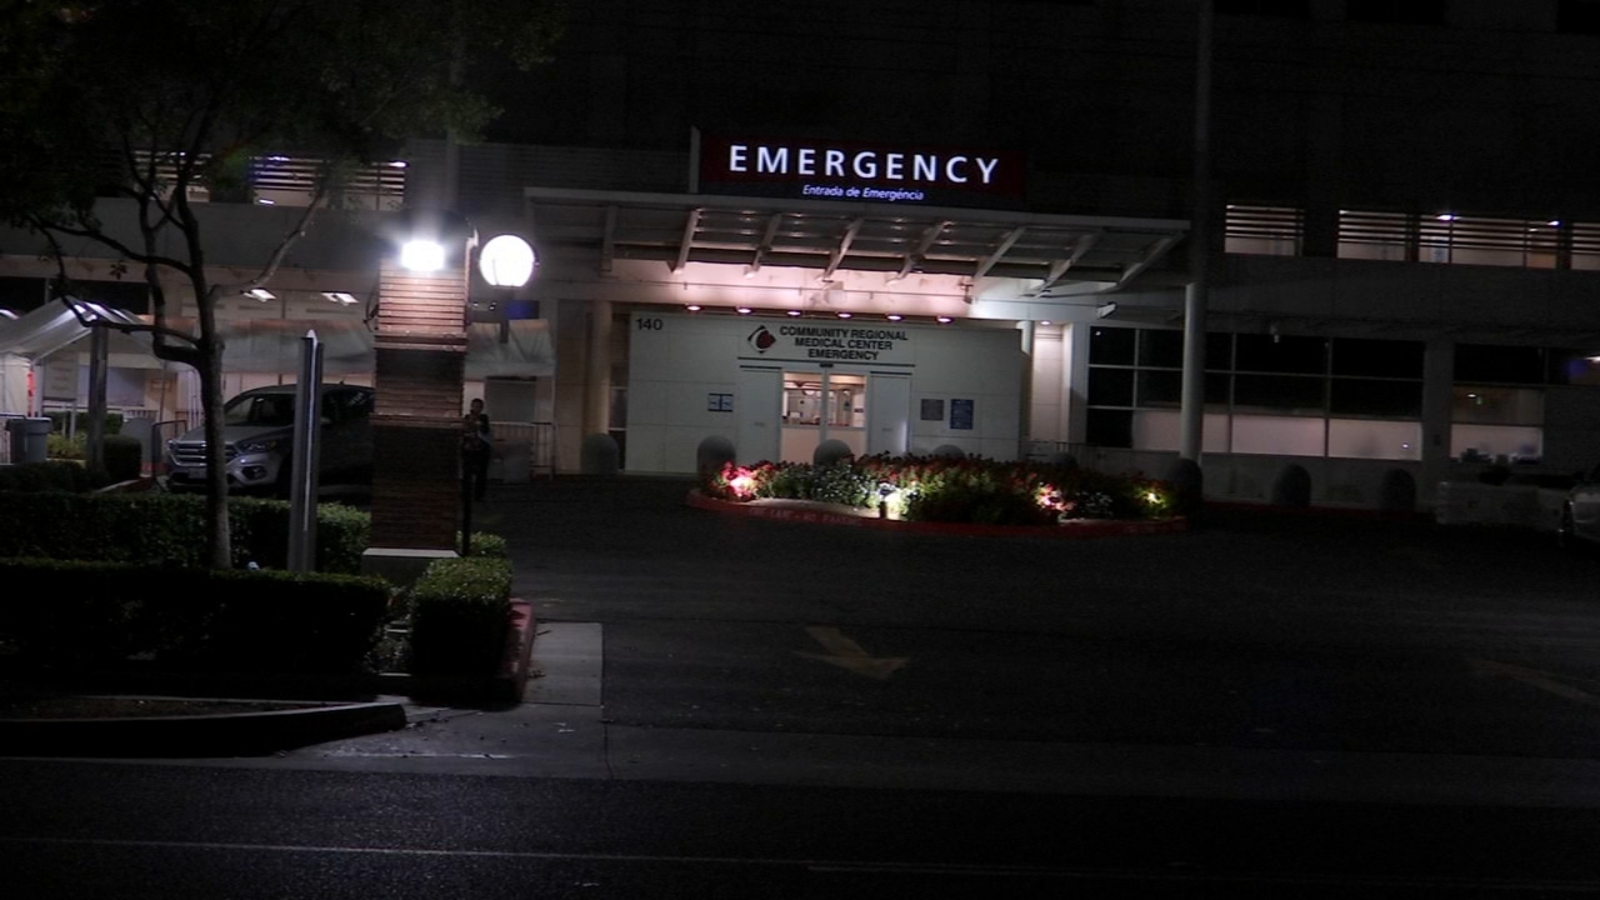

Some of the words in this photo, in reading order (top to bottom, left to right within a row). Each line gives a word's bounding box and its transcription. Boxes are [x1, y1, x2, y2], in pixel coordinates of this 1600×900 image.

[729, 144, 999, 184] EMERGENCY
[802, 184, 844, 197] Entrada
[845, 186, 861, 198] de
[636, 317, 664, 331] 140
[779, 325, 849, 338] COMMUNITY
[850, 328, 909, 341] REGIONAL
[794, 337, 846, 348] MEDICAL
[847, 339, 893, 350] CENTER
[807, 348, 879, 361] EMERGENCY
